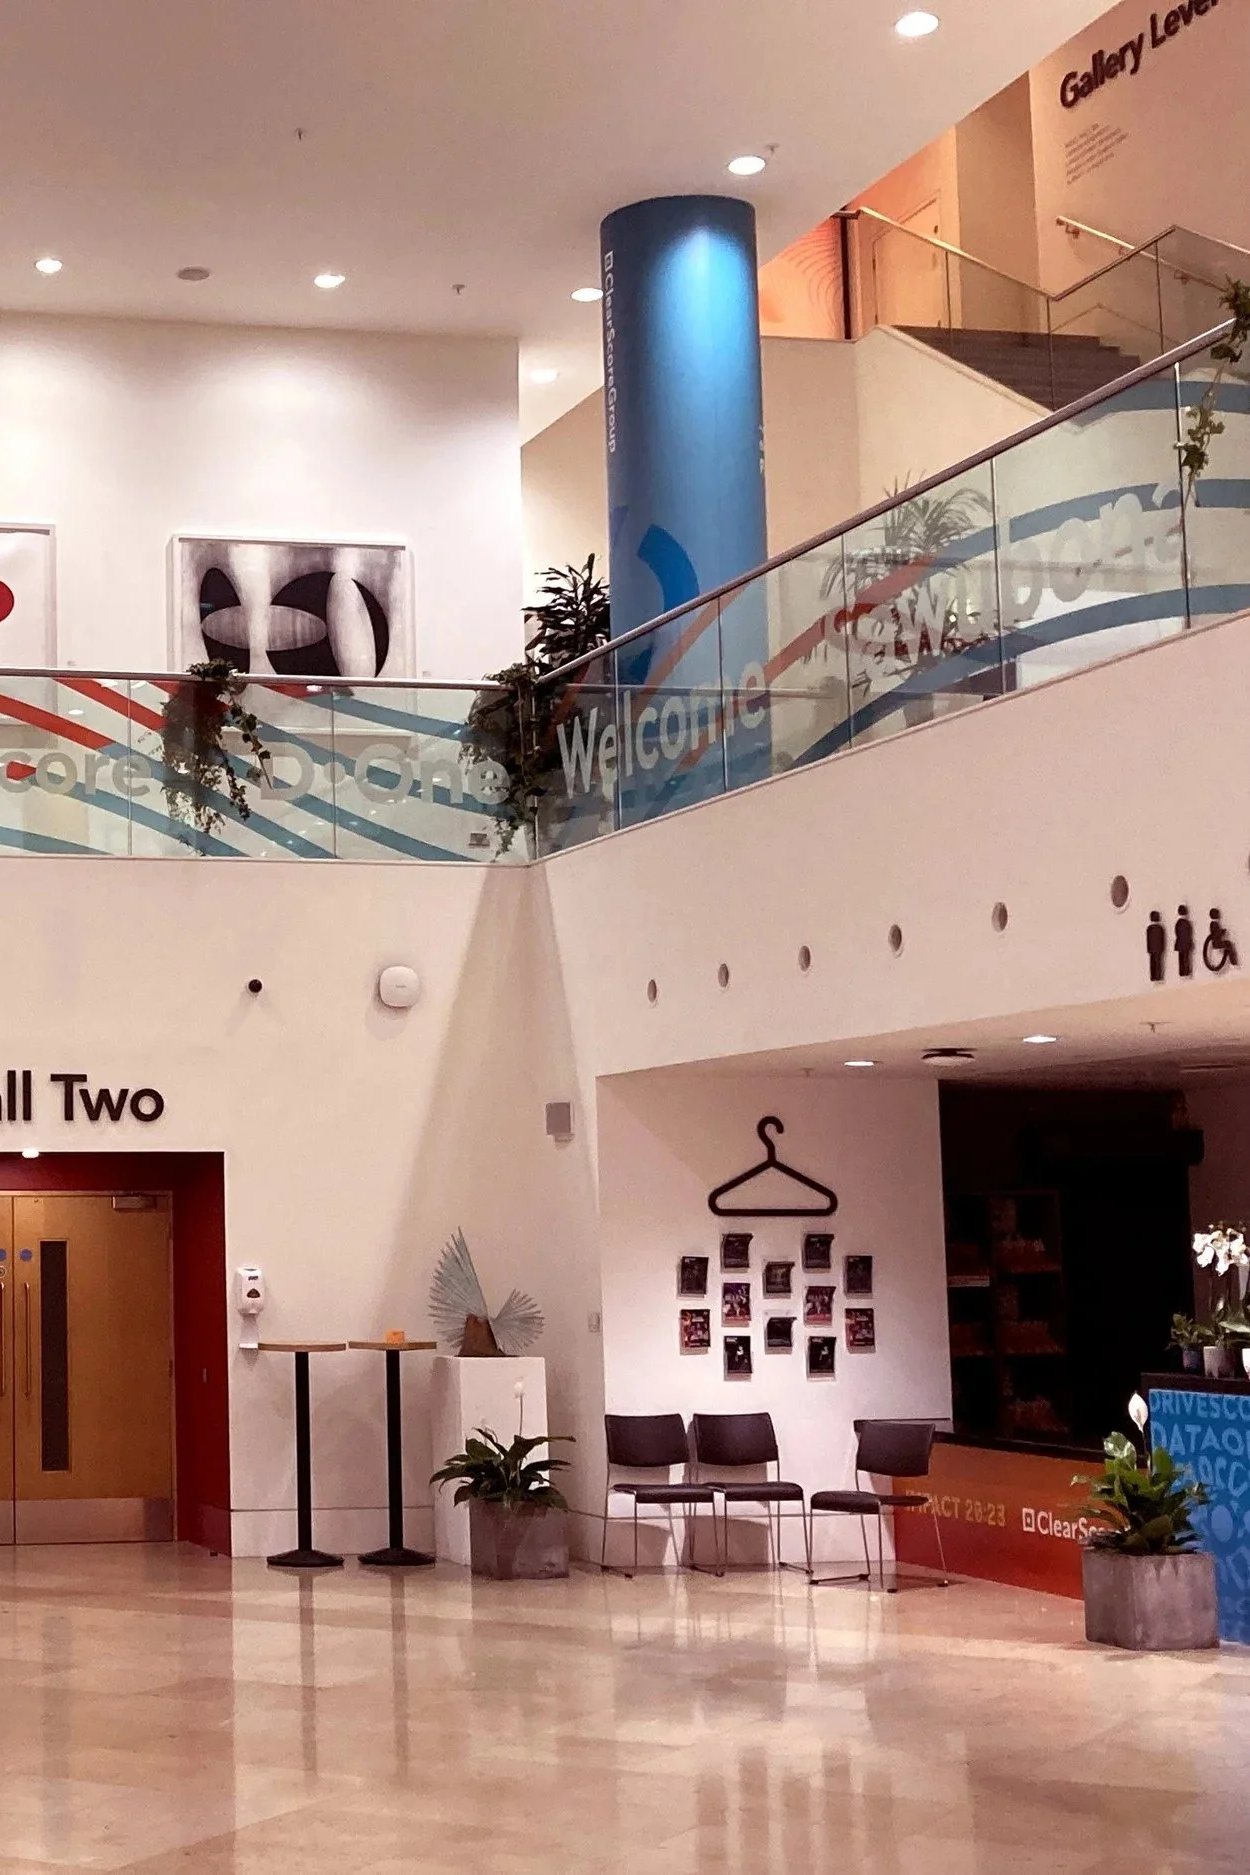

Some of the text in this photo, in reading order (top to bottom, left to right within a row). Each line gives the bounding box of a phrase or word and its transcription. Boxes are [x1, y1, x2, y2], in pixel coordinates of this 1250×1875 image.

[1060, 0, 1219, 109] Gallery Leve
[556, 659, 767, 799] Welcome
[50, 1073, 165, 1121] Two
